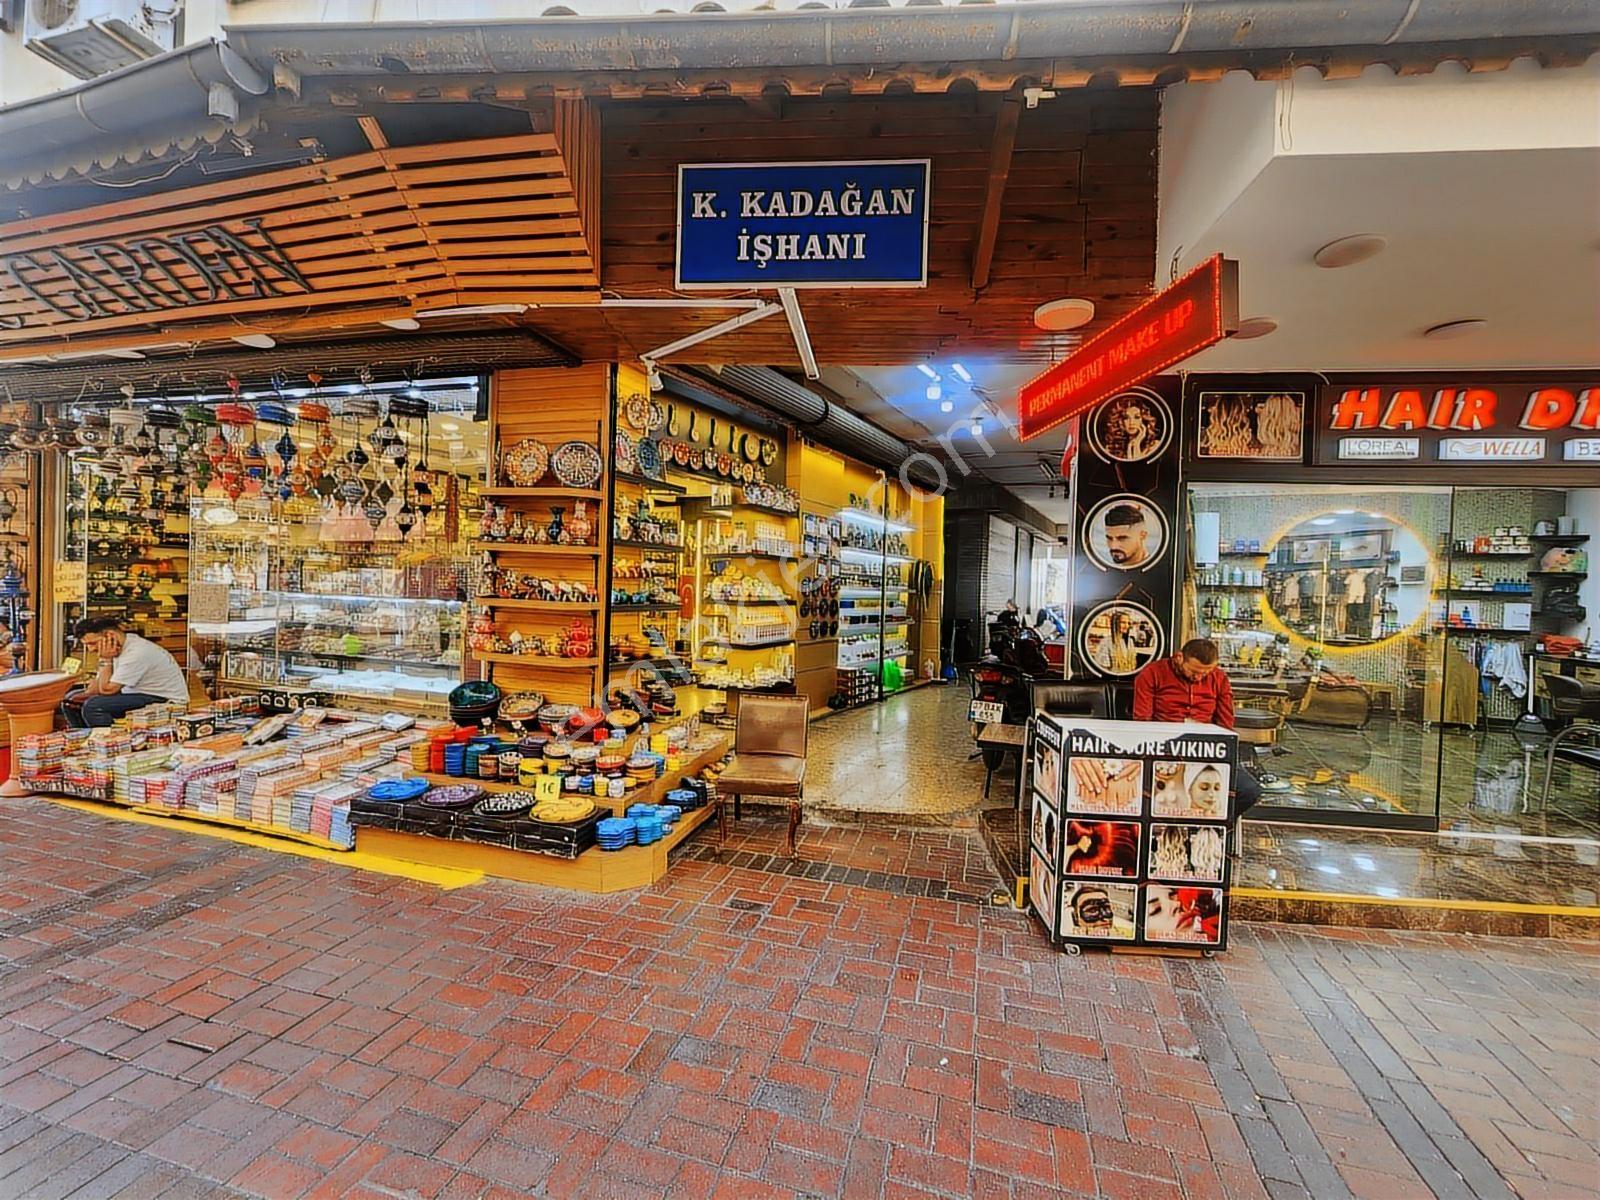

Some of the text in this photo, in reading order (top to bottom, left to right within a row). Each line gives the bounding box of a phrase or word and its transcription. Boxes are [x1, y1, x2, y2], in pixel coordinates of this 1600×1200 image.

[692, 182, 915, 218] K. KADAĞAN
[737, 228, 866, 268] İŞHANI
[6, 217, 314, 321] GARDEN
[1029, 299, 1194, 417] PERMANENT MAKE UP
[1330, 388, 1497, 430] HAIR
[1483, 441, 1541, 455] WELLA
[1072, 736, 1111, 754] HAIR
[1170, 740, 1227, 758] VIKING
